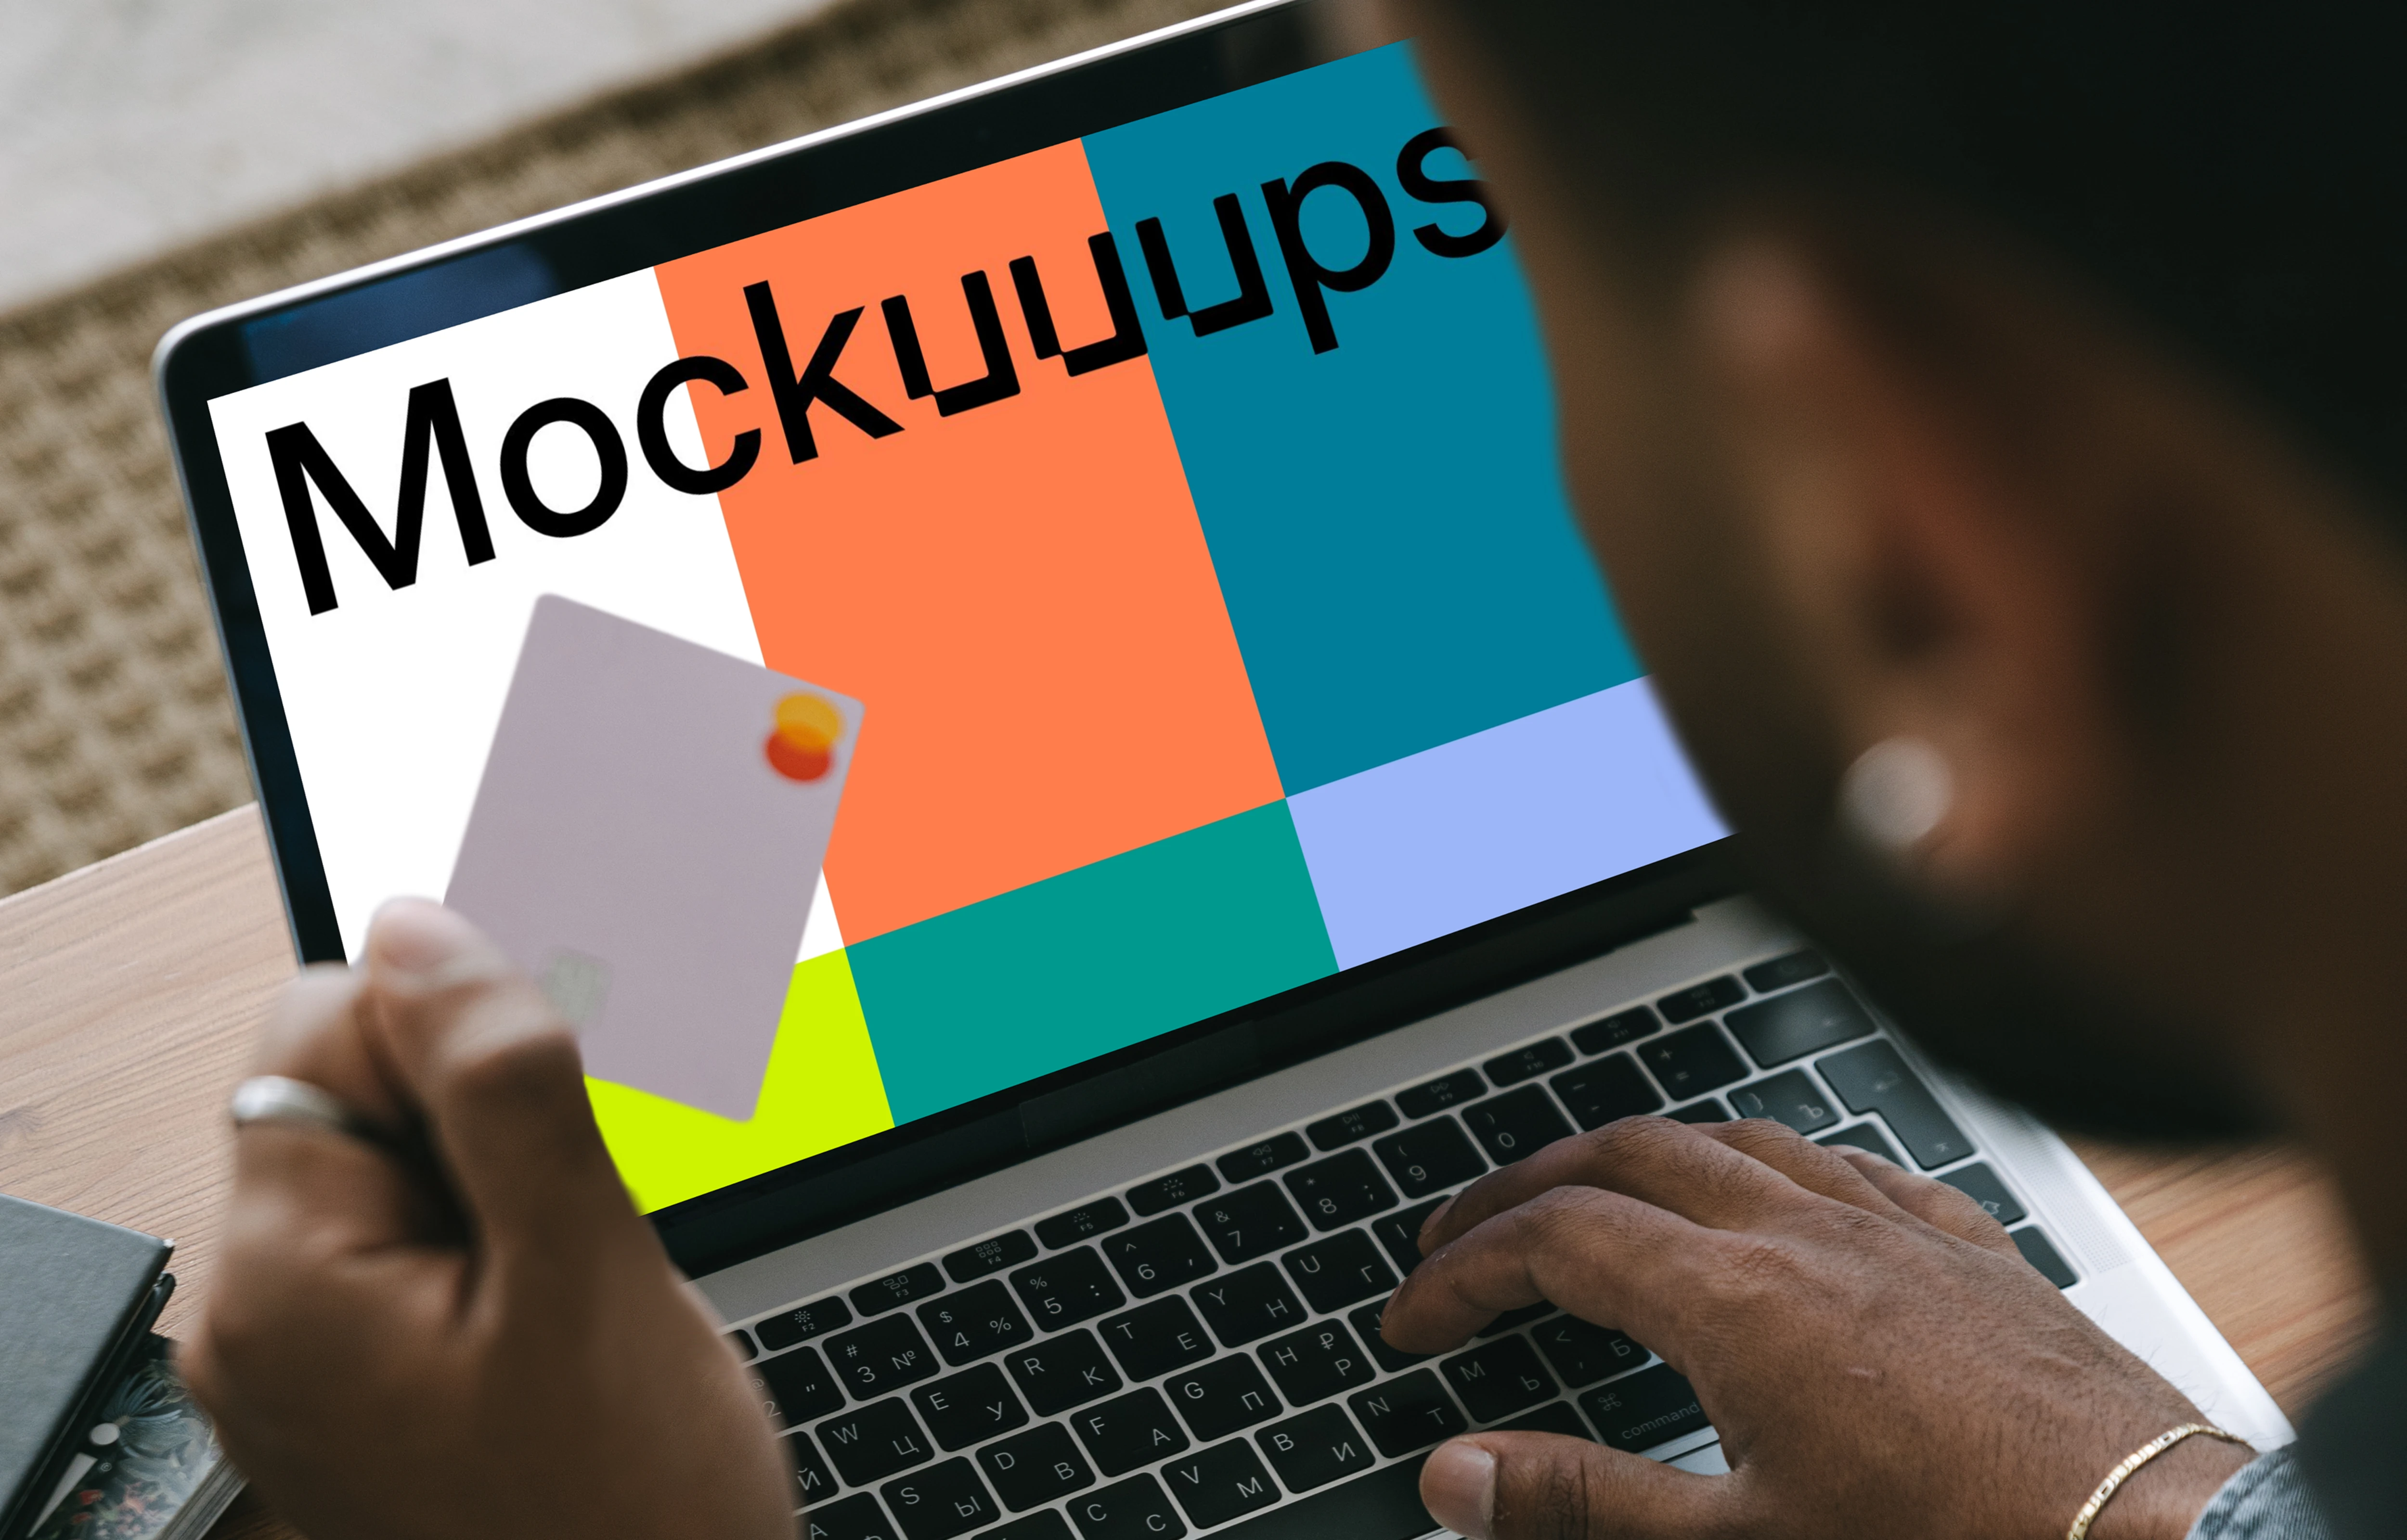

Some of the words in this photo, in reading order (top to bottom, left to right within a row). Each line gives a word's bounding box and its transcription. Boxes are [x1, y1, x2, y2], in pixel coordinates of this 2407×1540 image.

[264, 126, 1509, 616] Mockuuups
[1440, 1092, 1453, 1102] F9
[1351, 1124, 1365, 1133] F8
[1261, 1156, 1274, 1166] F7
[1409, 1165, 1426, 1181] 9
[1171, 1189, 1185, 1199] F6
[1319, 1198, 1337, 1214] 8
[1215, 1211, 1230, 1222] &
[1080, 1222, 1094, 1232] F5
[1228, 1230, 1241, 1247] 7
[987, 1255, 1002, 1265] F4
[1299, 1255, 1320, 1273] U
[1138, 1264, 1155, 1280] 6
[1030, 1276, 1048, 1289] %
[895, 1288, 909, 1298] F3
[1209, 1288, 1226, 1305] Y
[1044, 1297, 1062, 1314] 5
[940, 1311, 952, 1323] $
[989, 1317, 1011, 1334] %
[802, 1322, 815, 1332] F2
[1116, 1322, 1133, 1339] T
[954, 1332, 970, 1348] 4
[1610, 1338, 1631, 1357] Б
[846, 1344, 857, 1358] #
[1275, 1347, 1298, 1366] H
[857, 1366, 875, 1383] 3
[1023, 1358, 1045, 1375] R
[1460, 1361, 1486, 1381] M
[750, 1378, 764, 1392] @
[1184, 1382, 1204, 1399] G
[763, 1400, 782, 1418] 2
[929, 1392, 949, 1411] E
[1241, 1391, 1264, 1411] П
[1367, 1397, 1390, 1416] N
[1089, 1416, 1105, 1435] F
[1621, 1401, 1701, 1439] command
[832, 1423, 858, 1444] W
[1273, 1433, 1294, 1451] B
[893, 1436, 919, 1455] Ц
[1332, 1442, 1356, 1462] И
[994, 1452, 1015, 1470] D
[797, 1467, 821, 1490] Й
[1180, 1466, 1199, 1484] V
[901, 1487, 920, 1504] S
[954, 1496, 981, 1517] Ы
[1087, 1503, 1107, 1521] C
